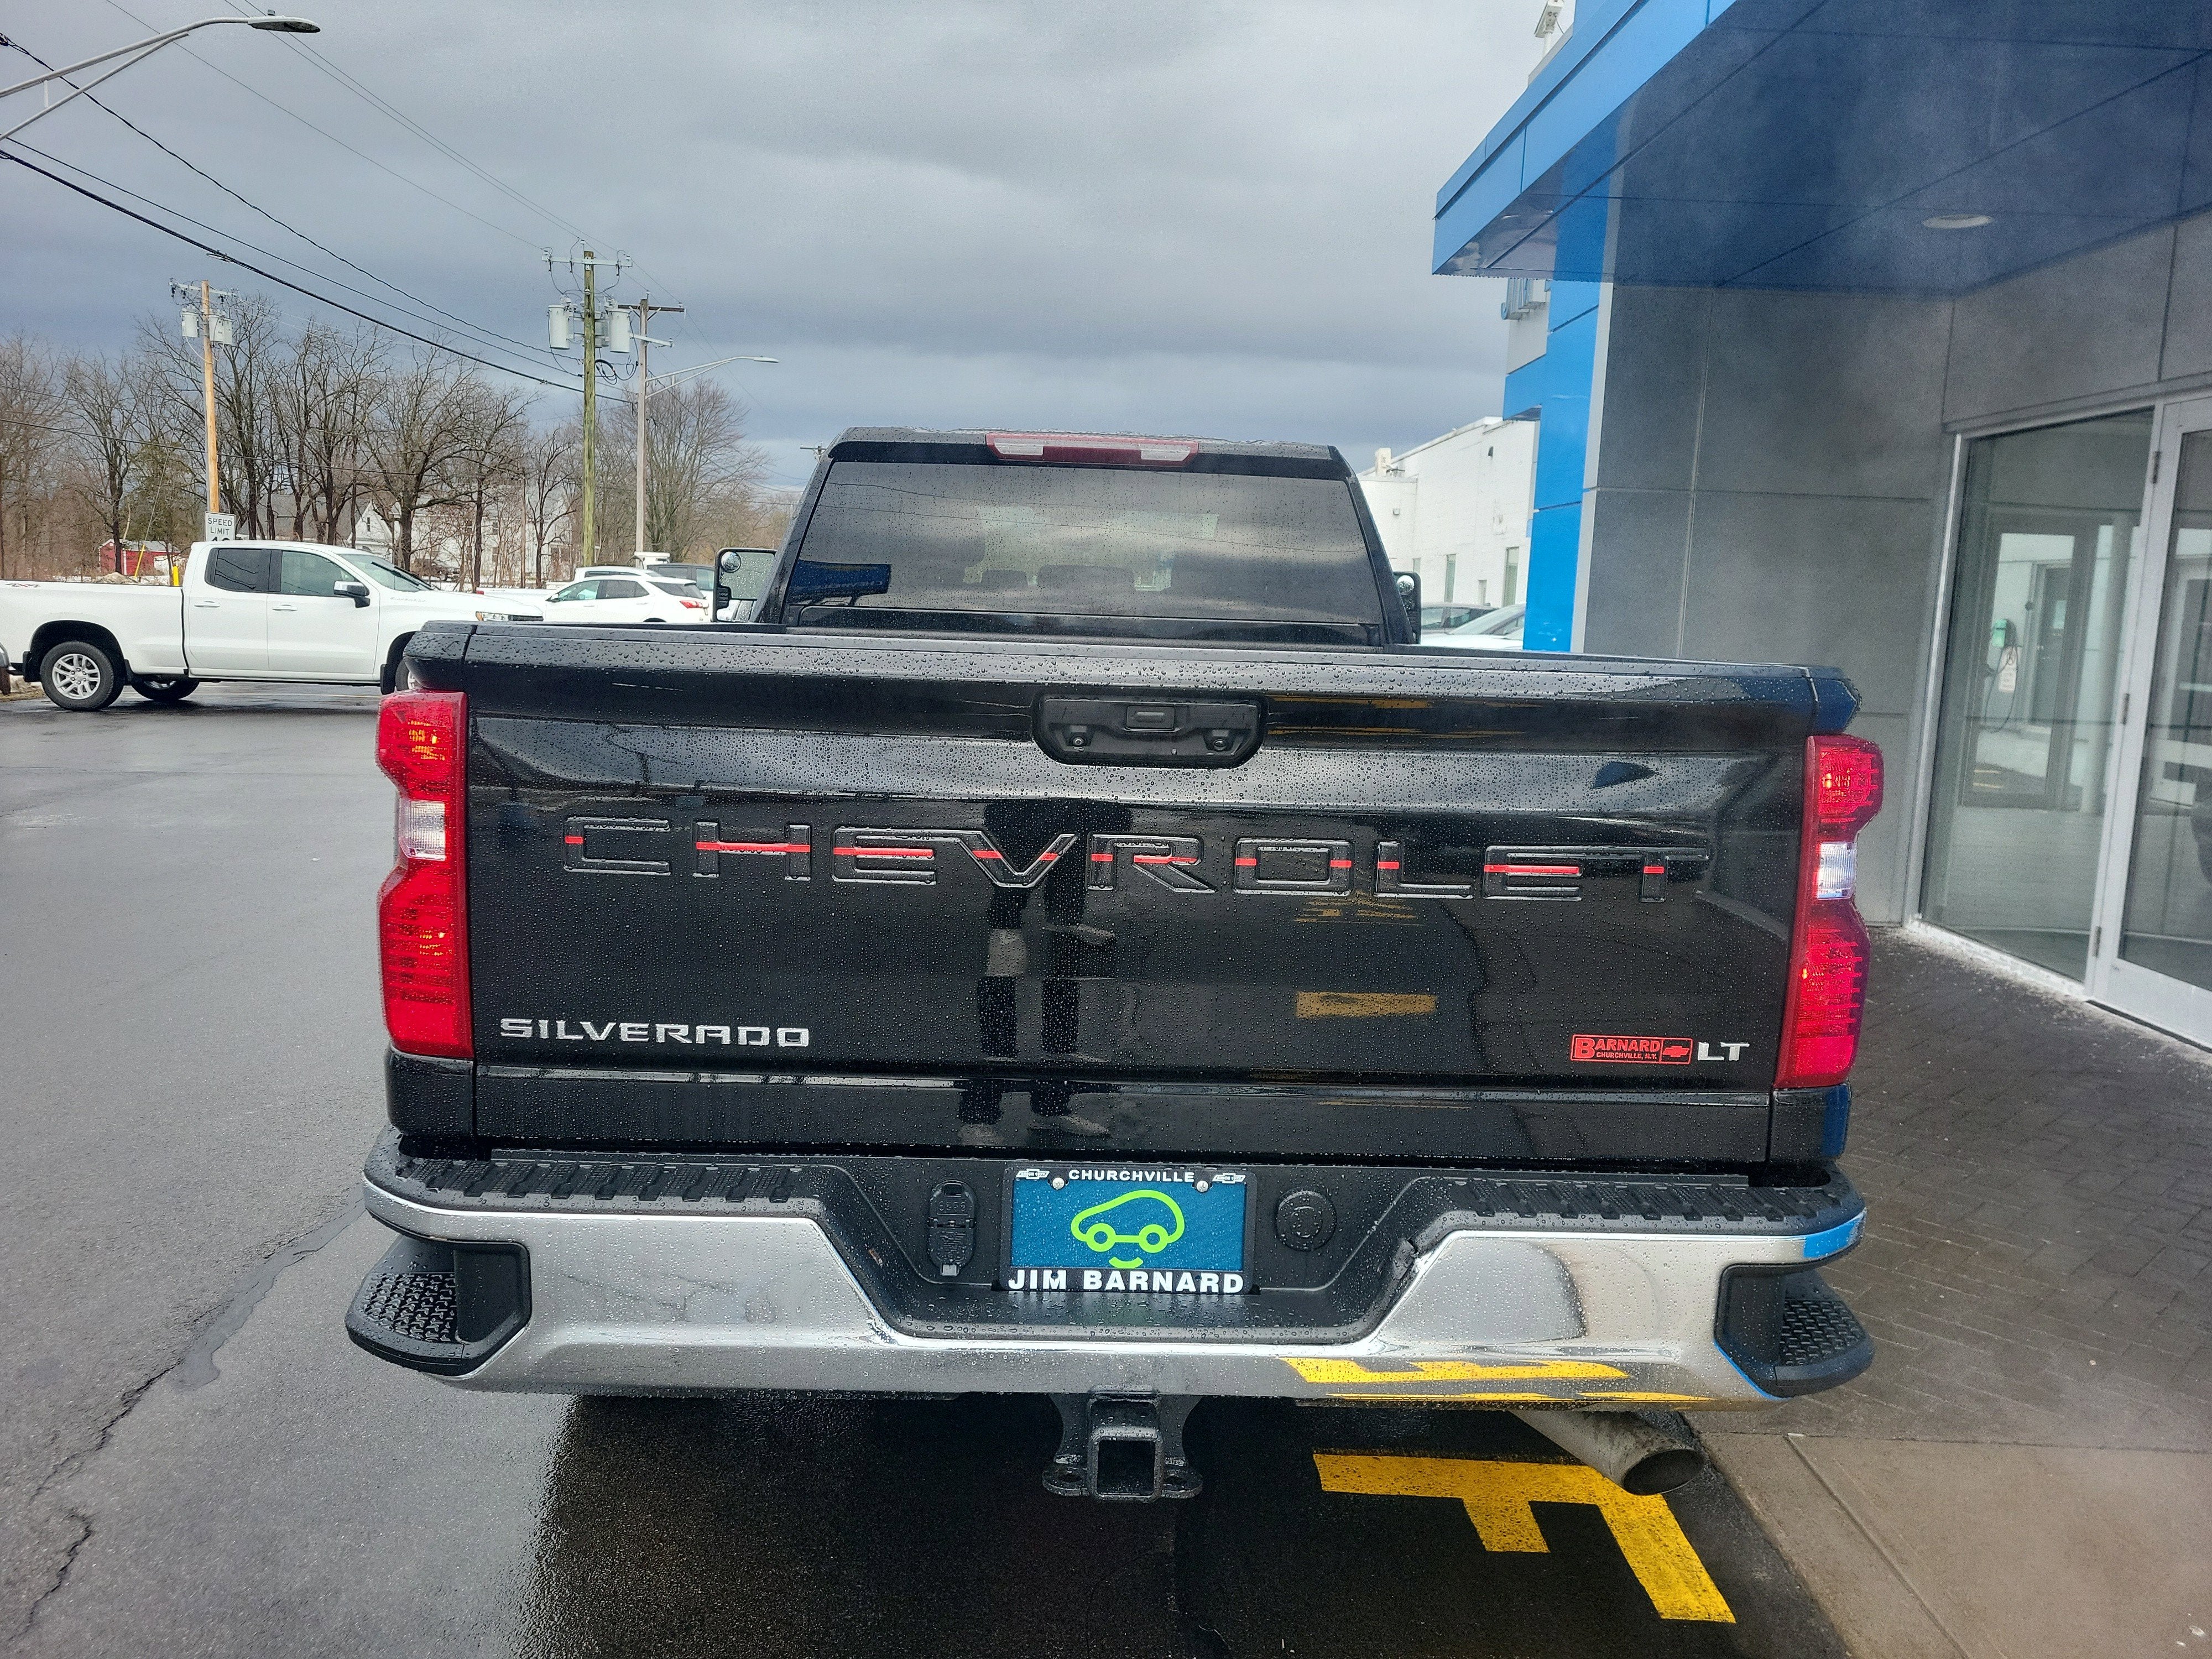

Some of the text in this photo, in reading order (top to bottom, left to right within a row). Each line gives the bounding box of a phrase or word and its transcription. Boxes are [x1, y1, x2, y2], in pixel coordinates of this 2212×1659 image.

[208, 518, 232, 526] SPEED
[562, 815, 1710, 903] CHEVROLET
[500, 1018, 809, 1047] SILVERADO
[1574, 1038, 1661, 1058] BARNARD
[1597, 1051, 1643, 1060] CHURCHVILLE,
[1698, 1042, 1750, 1061] LT
[1068, 1170, 1194, 1182] CHURCHVILLE
[1008, 1269, 1244, 1293] JIM BARNARD
